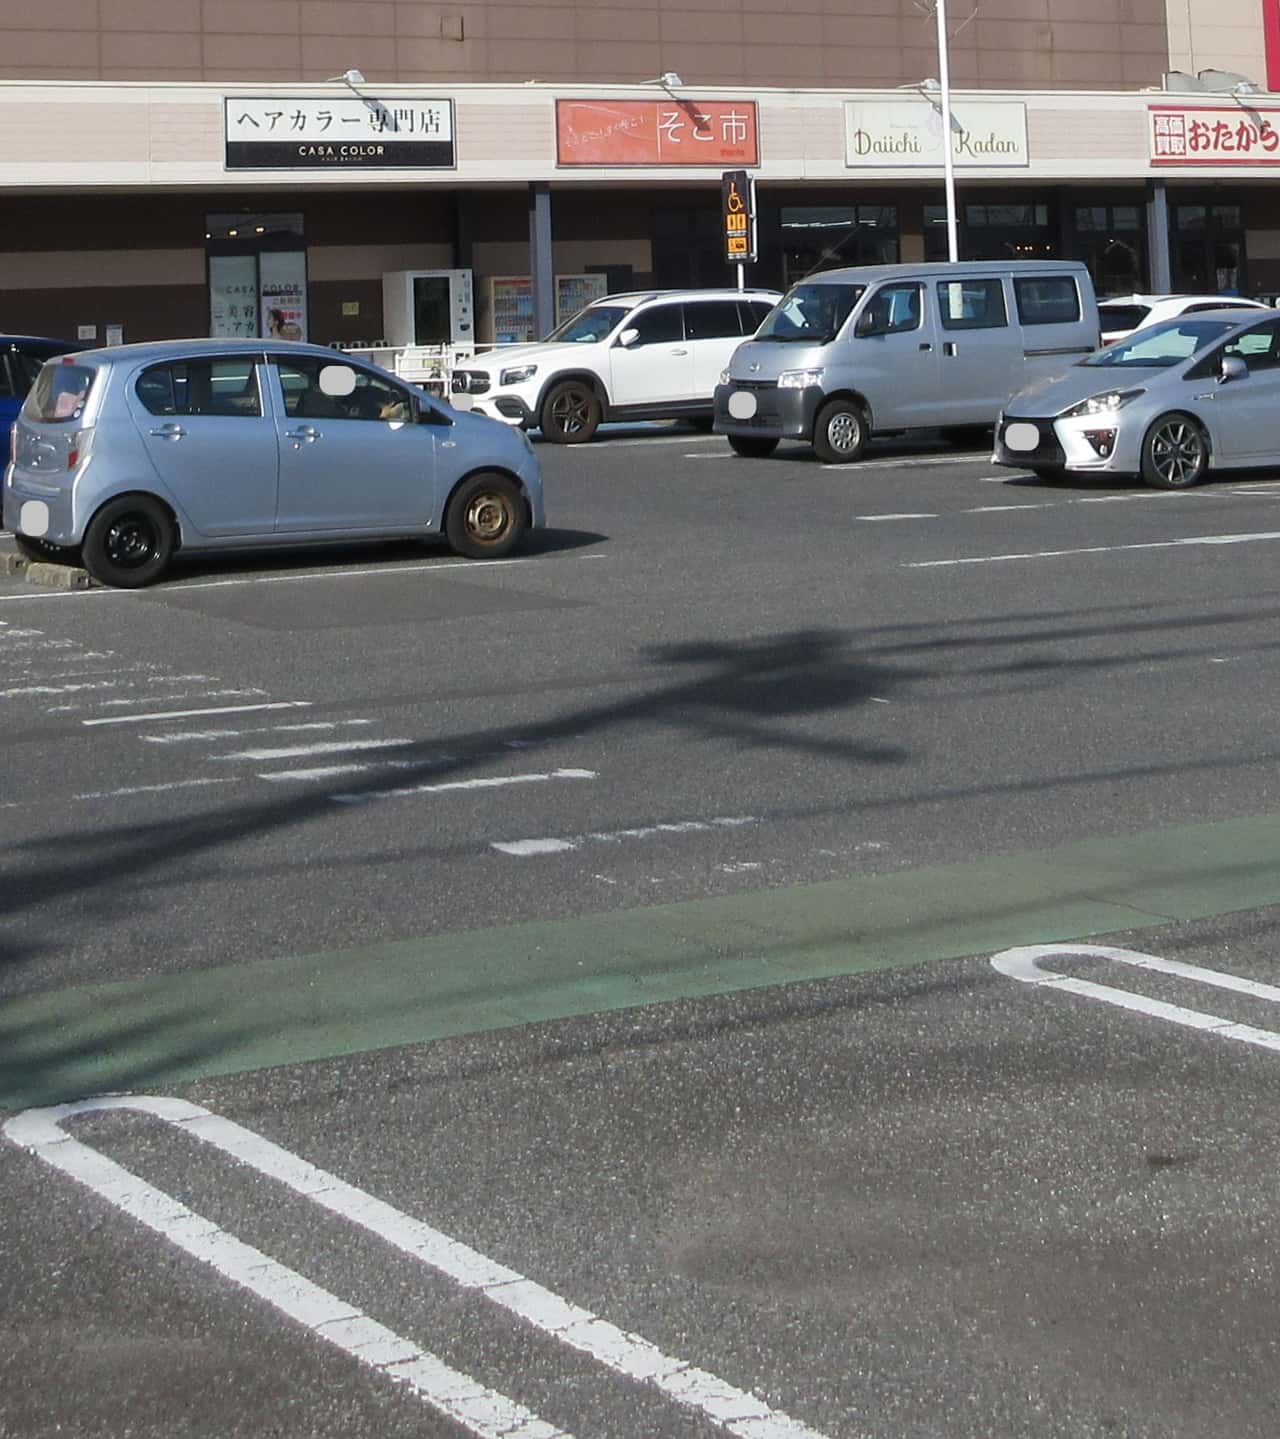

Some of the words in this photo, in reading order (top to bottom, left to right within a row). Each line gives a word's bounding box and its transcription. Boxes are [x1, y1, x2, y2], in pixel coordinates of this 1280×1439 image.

[236, 109, 441, 134] ヘアカラー専門店
[659, 109, 749, 145] そこ市
[298, 145, 334, 156] CASA
[340, 145, 385, 156] COLOR
[853, 127, 922, 156] Daiichi
[954, 128, 1020, 158] Kadan
